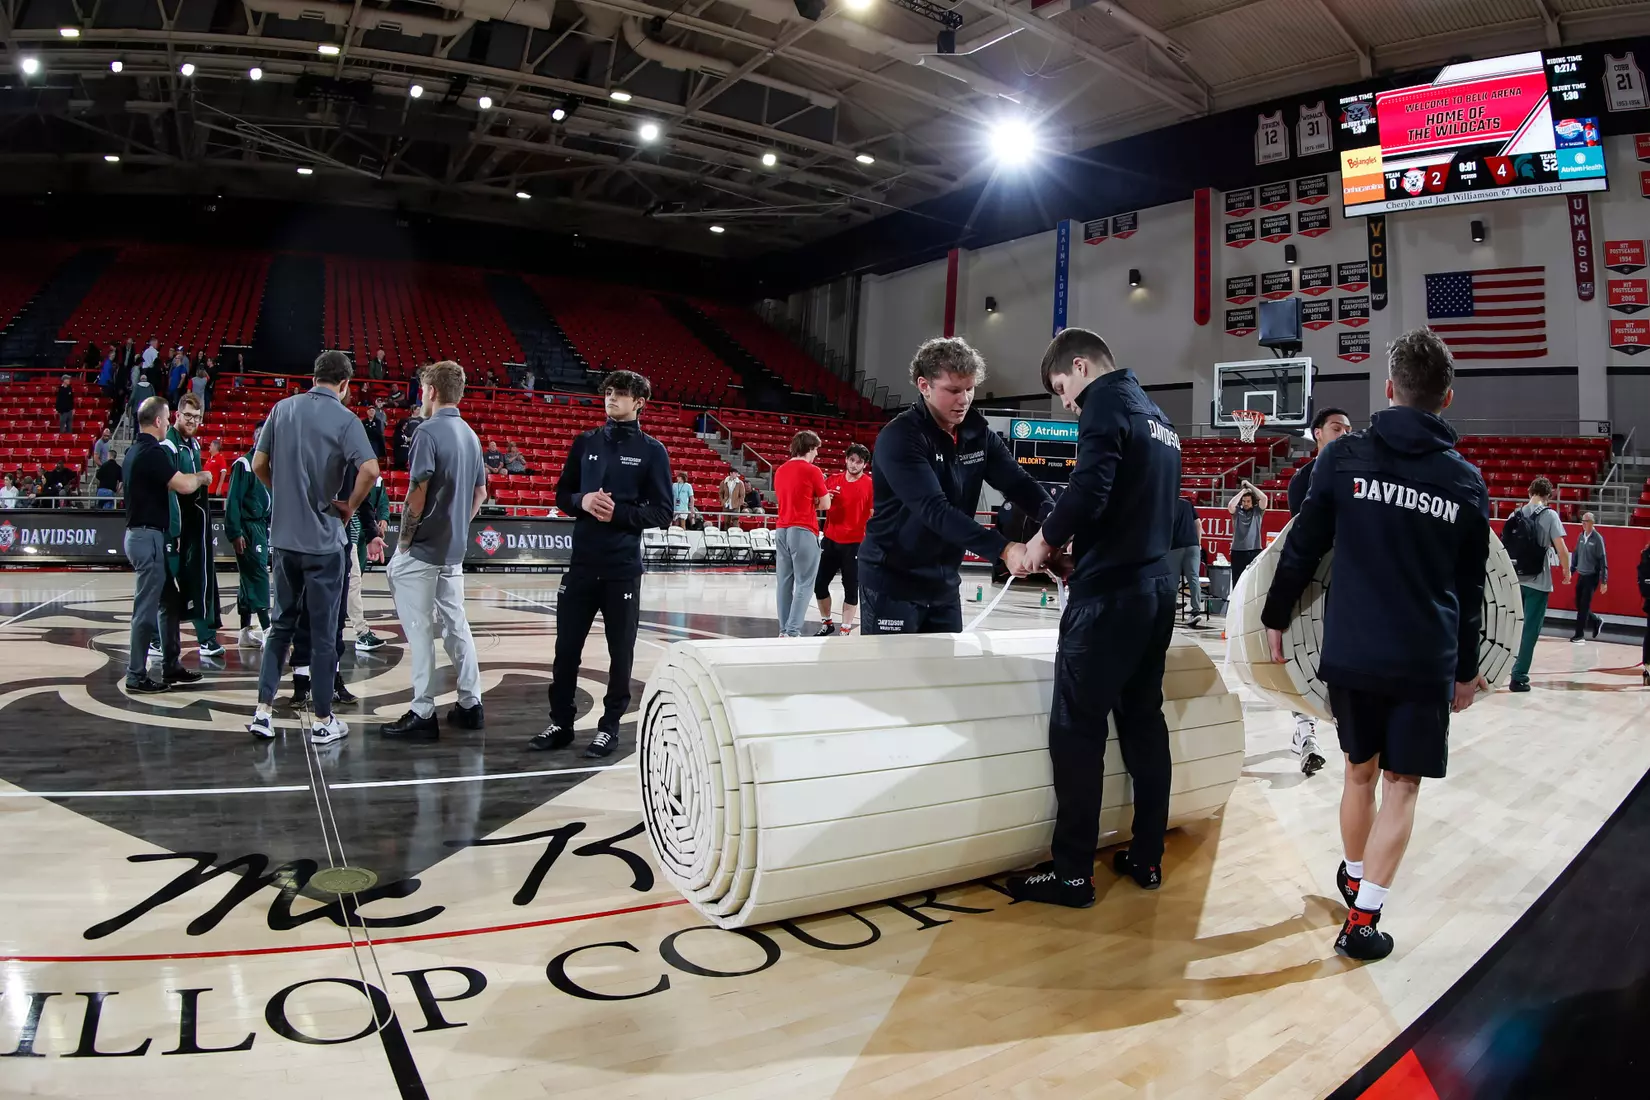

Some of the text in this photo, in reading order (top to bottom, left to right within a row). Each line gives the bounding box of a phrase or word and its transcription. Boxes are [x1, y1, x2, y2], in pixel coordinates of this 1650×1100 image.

[1567, 54, 1582, 62] TIME
[1572, 82, 1586, 90] TIME
[1615, 73, 1633, 90] 21
[1358, 93, 1374, 101] TIME
[1405, 87, 1522, 113] WELCOME TO BELK ARENA
[1426, 106, 1486, 126] HOME OF
[1307, 120, 1321, 136] 31
[1408, 117, 1500, 141] THE WILDCATS
[1265, 129, 1278, 146] 12
[1347, 156, 1377, 169] Bojangles
[1459, 161, 1477, 172] 0:01
[1385, 171, 1400, 179] TEAM
[1496, 163, 1507, 177] 4
[1431, 171, 1441, 186] 2
[1299, 182, 1326, 191] CHAMPIONS
[1389, 178, 1397, 190] 0
[1262, 188, 1288, 197] CHAMPIONS
[1386, 183, 1563, 210] Cheryle and Joel Williamson '67 Video Board
[1227, 195, 1252, 203] CHAMPIONS
[1300, 214, 1328, 223] CHAMPIONS
[1262, 220, 1288, 229] CHAMPIONS
[1227, 226, 1253, 234] CHAMPIONS
[1573, 198, 1589, 273] UMASS
[1370, 222, 1384, 278] VCU
[1302, 272, 1329, 281] CHAMPIONS
[1340, 267, 1368, 276] CHAMPIONS
[1228, 281, 1254, 290] CHAMPIONS
[1263, 276, 1290, 285] CHAMPIONS
[1302, 306, 1330, 314] CHAMPIONS
[1341, 302, 1370, 310] CHAMPIONS
[1228, 315, 1254, 323] CHAMPIONS
[1341, 337, 1371, 346] CHAMPIONS
[1034, 425, 1079, 437] Atrium H
[1147, 419, 1182, 451] DAVIDSO
[1018, 457, 1046, 465] WILDCATS
[1066, 459, 1078, 467] SPA
[1353, 477, 1460, 524] DAVIDSON
[20, 528, 97, 546] DAVIDSON
[506, 533, 573, 550] DAVIDSO
[546, 876, 1030, 1001] COUR
